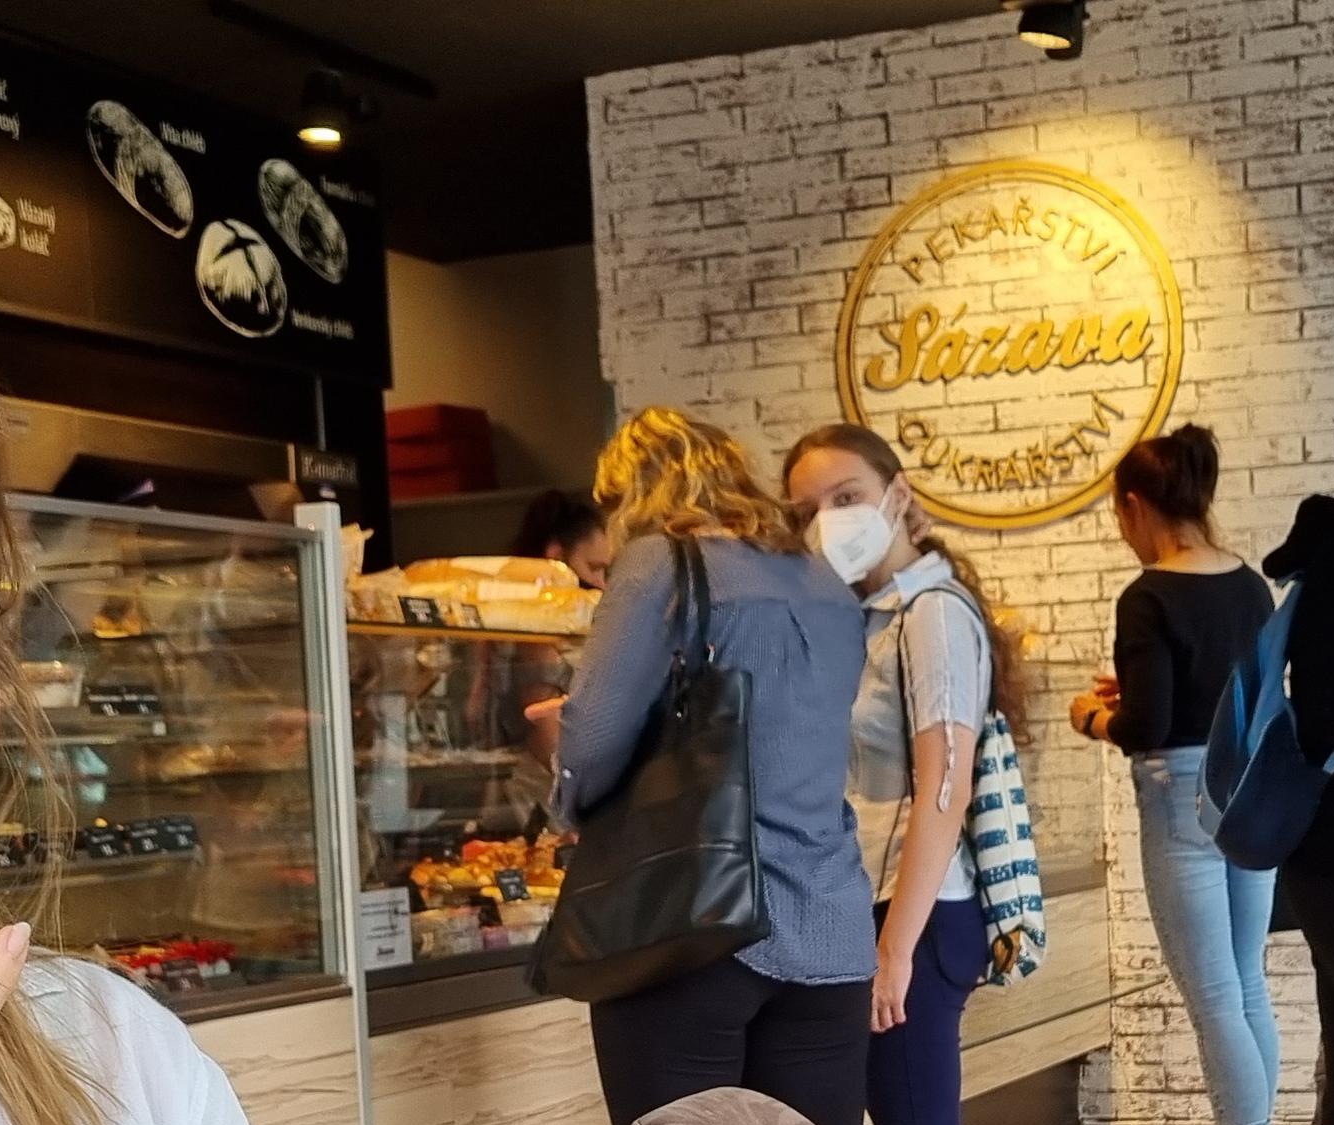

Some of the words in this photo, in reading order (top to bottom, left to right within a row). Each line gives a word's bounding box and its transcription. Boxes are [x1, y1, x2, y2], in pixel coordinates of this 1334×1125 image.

[902, 197, 1128, 284] PEKAŘSTVÍ
[865, 302, 1154, 392] Sázava
[897, 391, 1125, 490] CUKRÁŘSTVÍ
